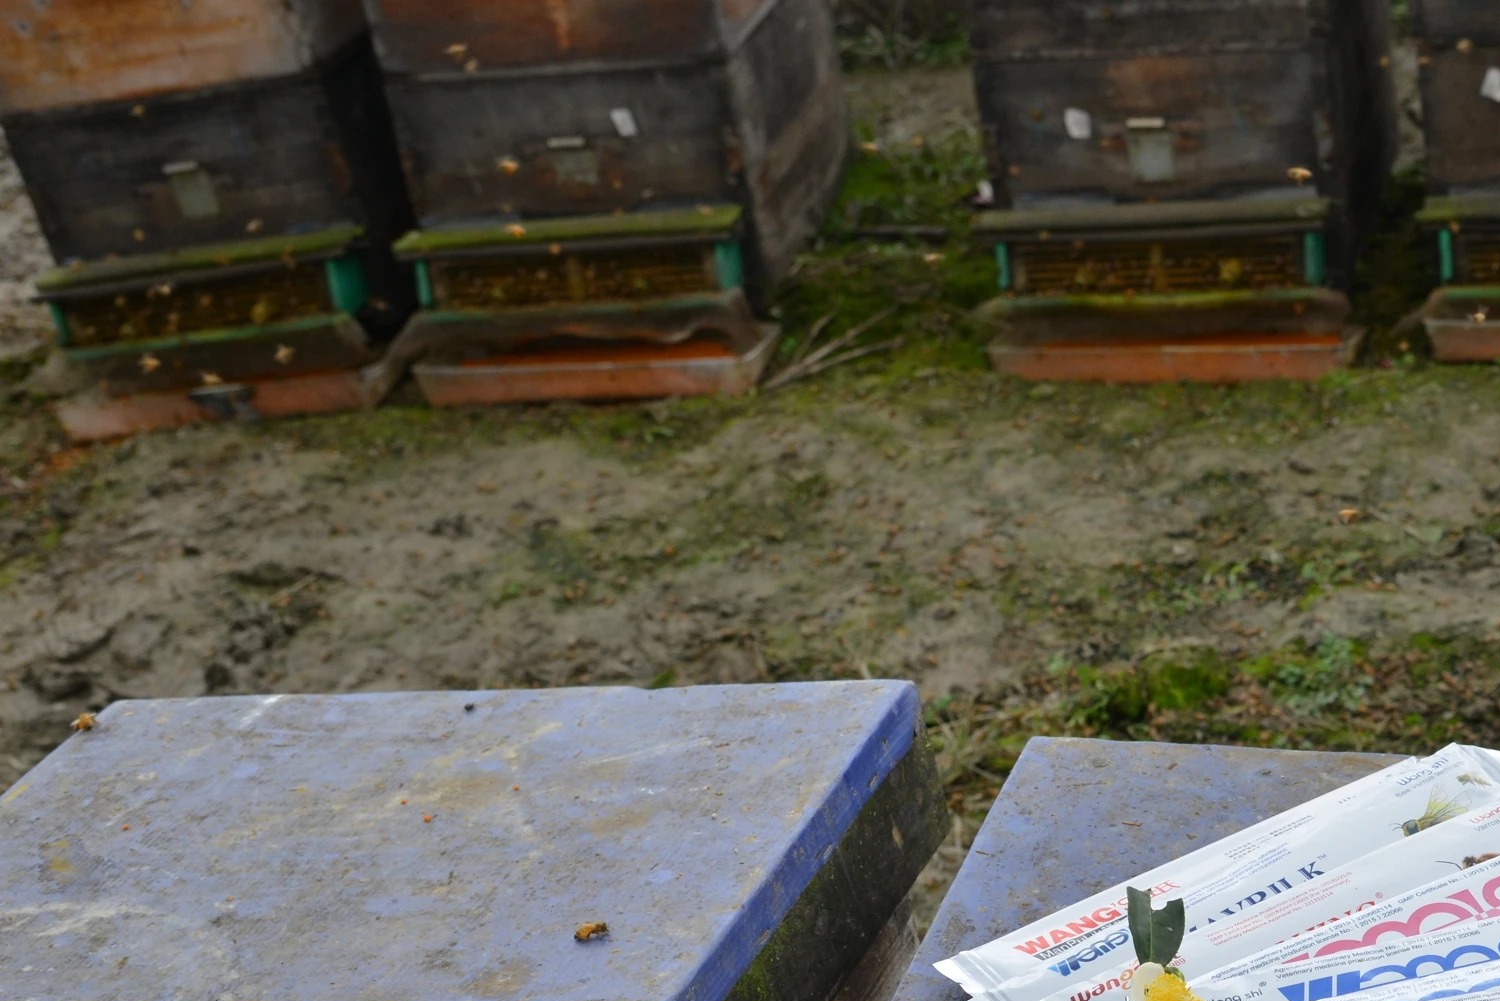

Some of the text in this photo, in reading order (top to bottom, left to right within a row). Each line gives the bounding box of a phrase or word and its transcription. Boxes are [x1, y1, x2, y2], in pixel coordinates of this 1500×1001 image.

[1474, 818, 1500, 832] Varroa
[1397, 895, 1415, 905] GMP
[1415, 882, 1449, 897] Certificate
[1244, 988, 1263, 1001] shi
